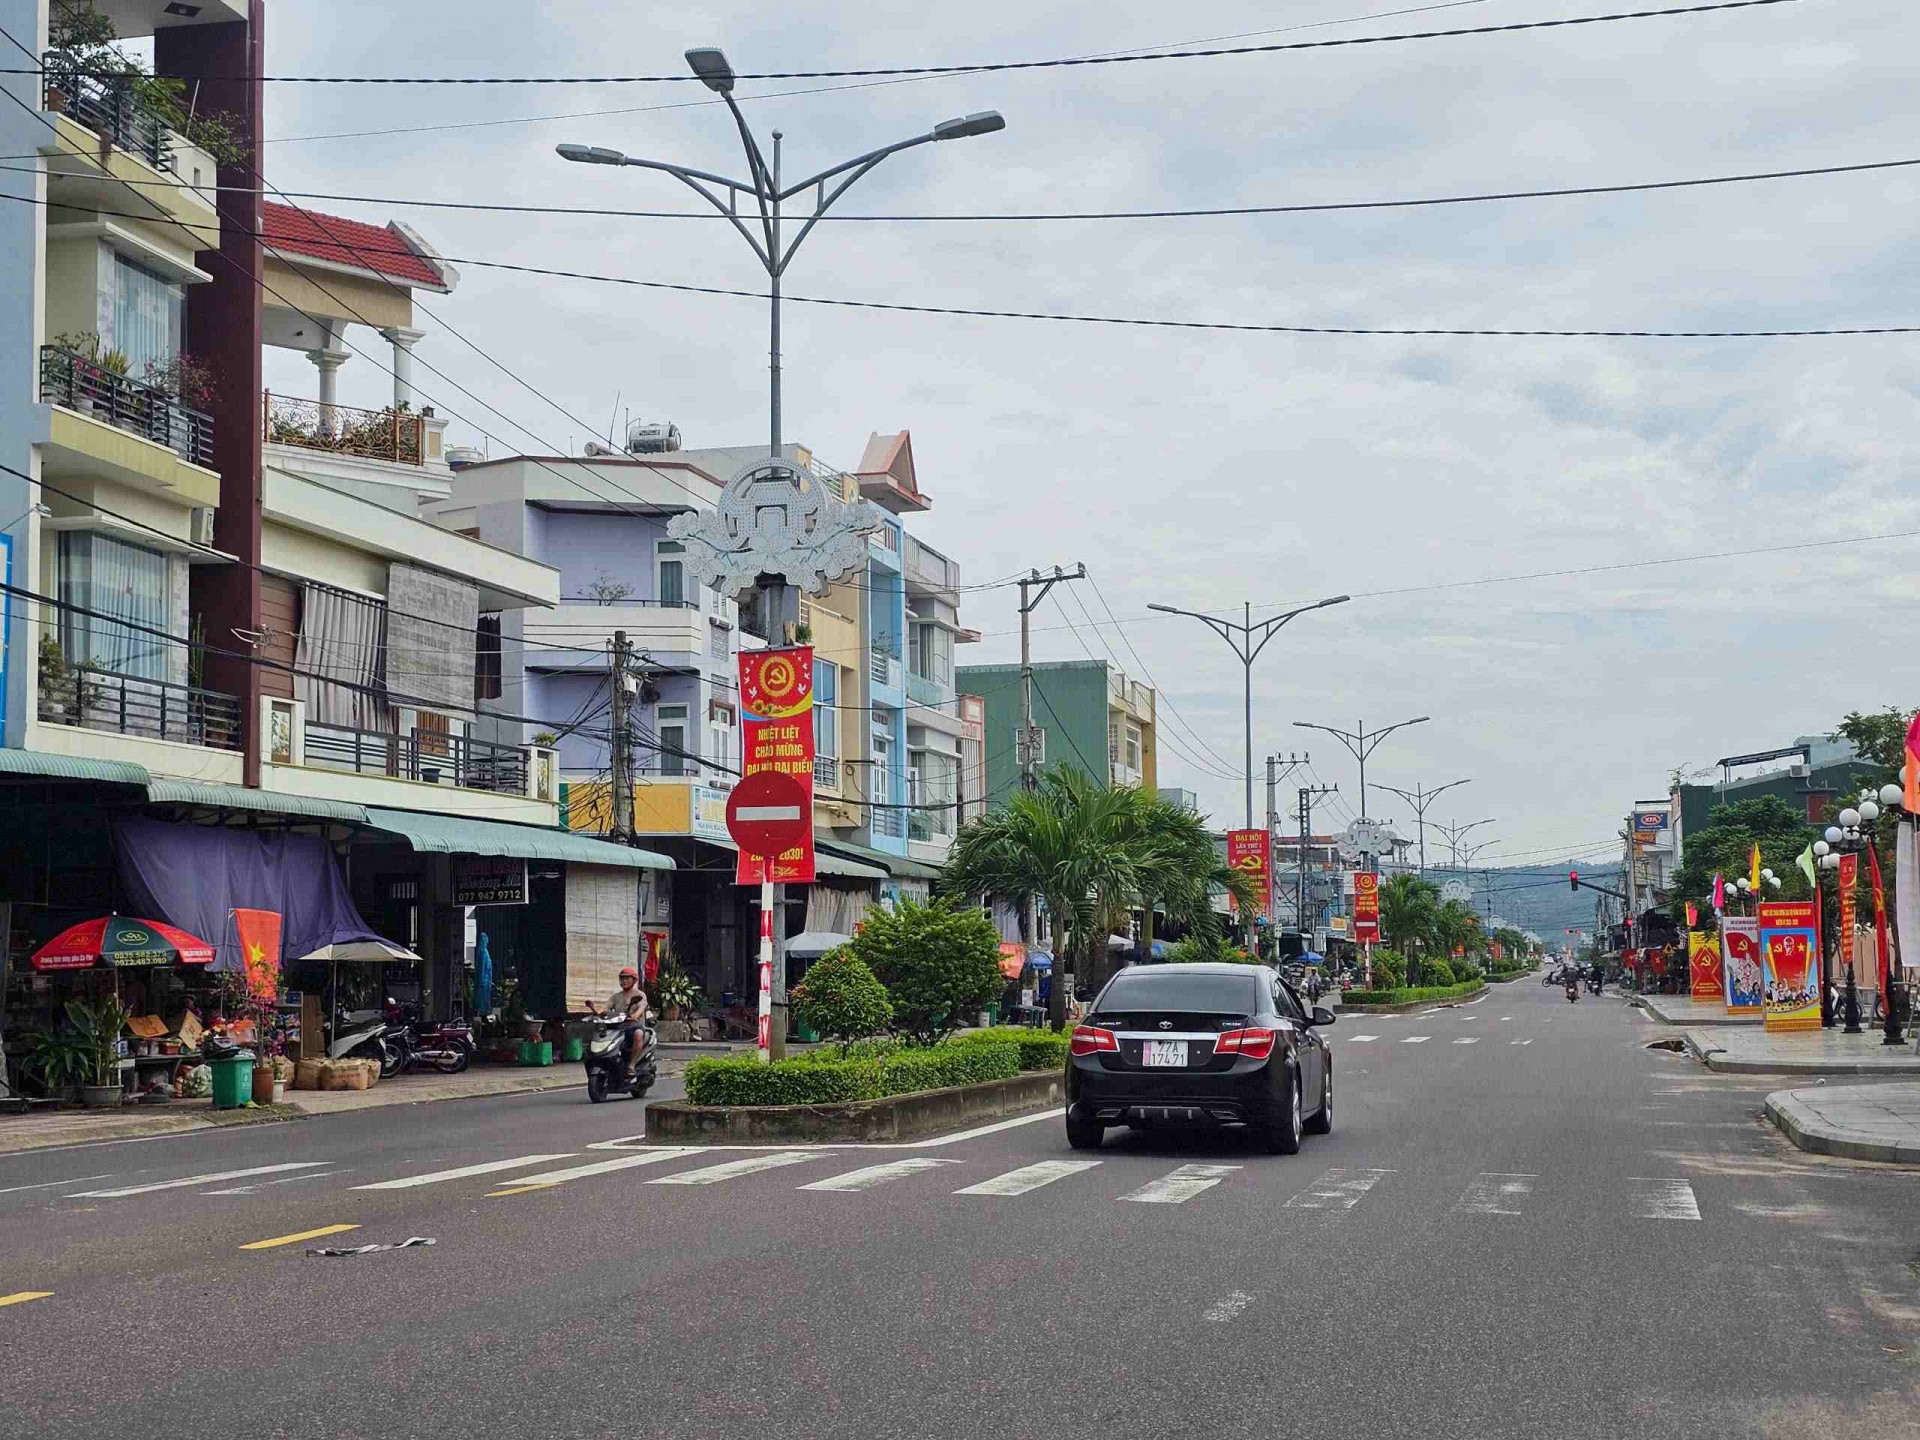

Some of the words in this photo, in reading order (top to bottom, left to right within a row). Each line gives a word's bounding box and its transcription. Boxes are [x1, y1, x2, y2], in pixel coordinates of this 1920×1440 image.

[758, 725, 779, 741] NHIỆT
[781, 724, 800, 741] LIỆT
[755, 743, 774, 758] CHÀO
[776, 741, 803, 756] MỪNG
[792, 756, 813, 773] BIỂU
[497, 889, 521, 900] 9712
[1158, 1041, 1178, 1053] 77A
[1152, 1053, 1184, 1065] 174.71
